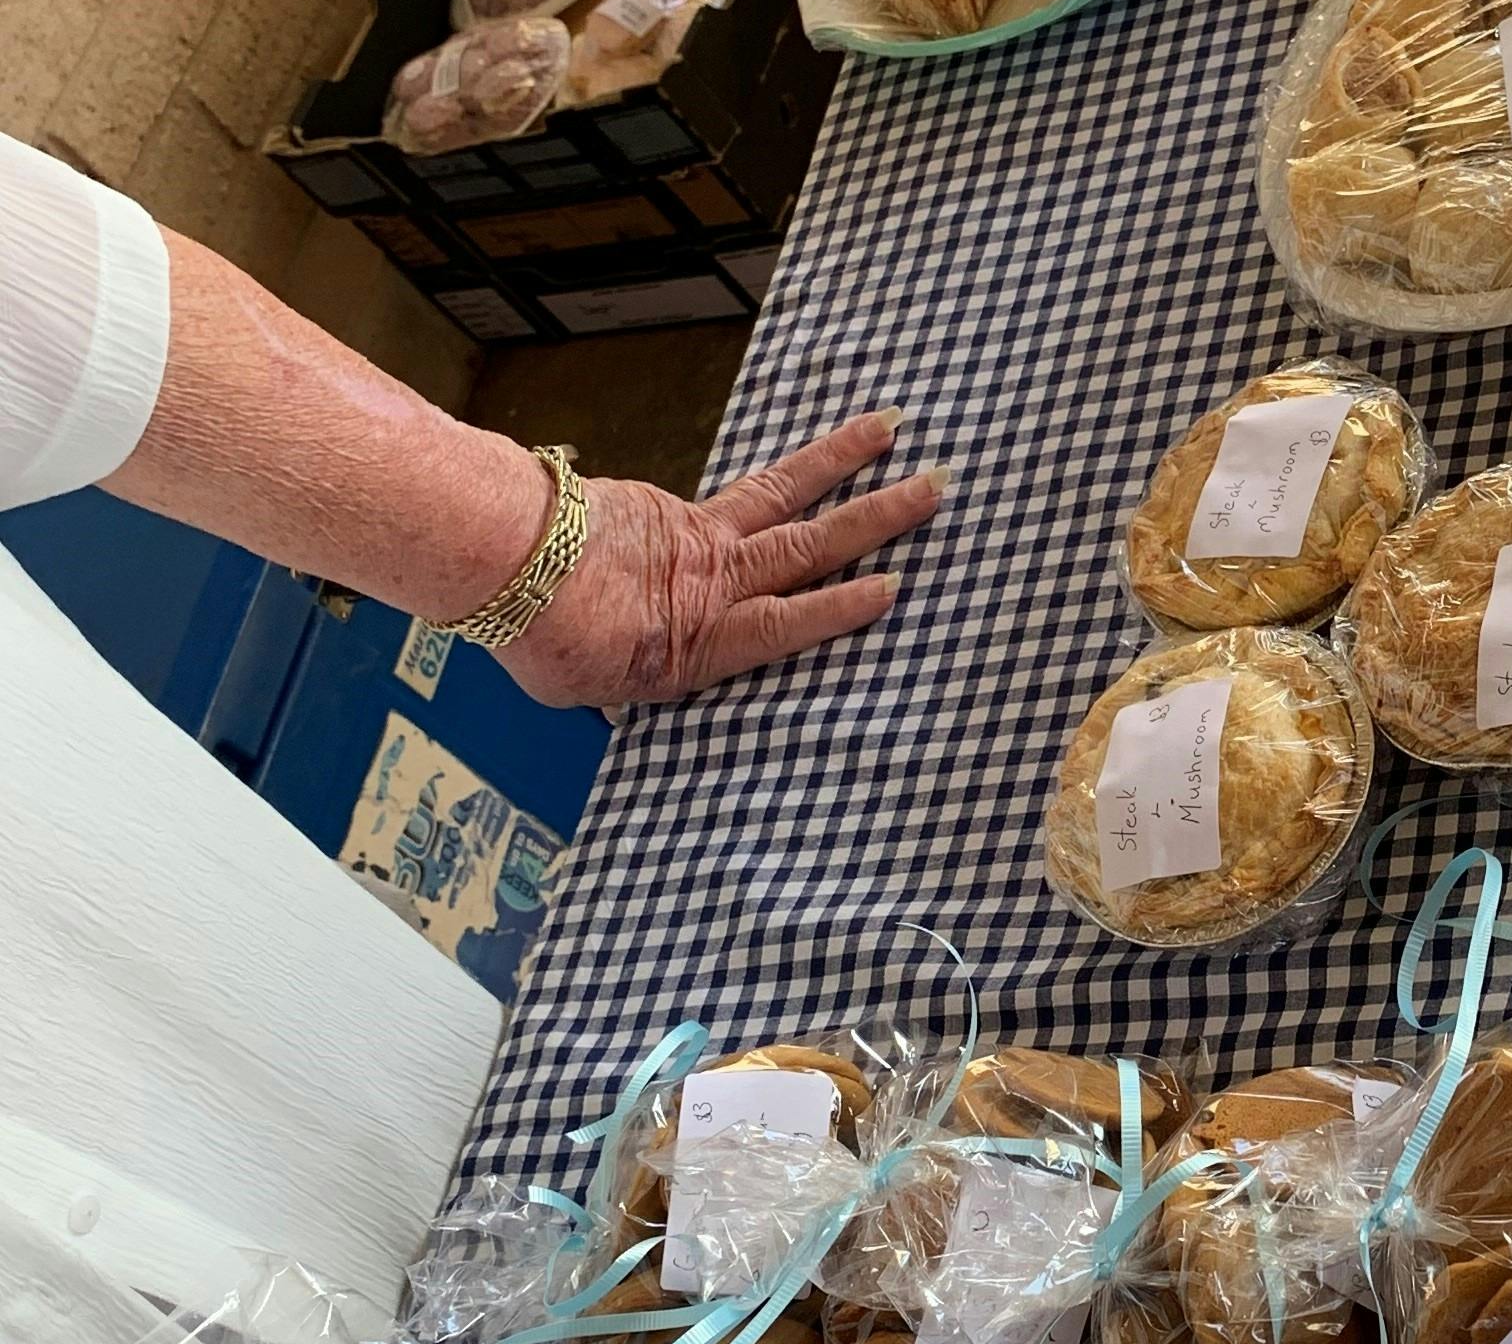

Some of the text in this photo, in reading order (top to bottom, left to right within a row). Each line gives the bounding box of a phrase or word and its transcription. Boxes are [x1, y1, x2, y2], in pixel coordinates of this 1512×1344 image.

[1209, 480, 1246, 529] Steak
[1257, 442, 1301, 533] Mushroom
[1179, 709, 1212, 824] Mushroom
[1110, 787, 1137, 851] Steak
